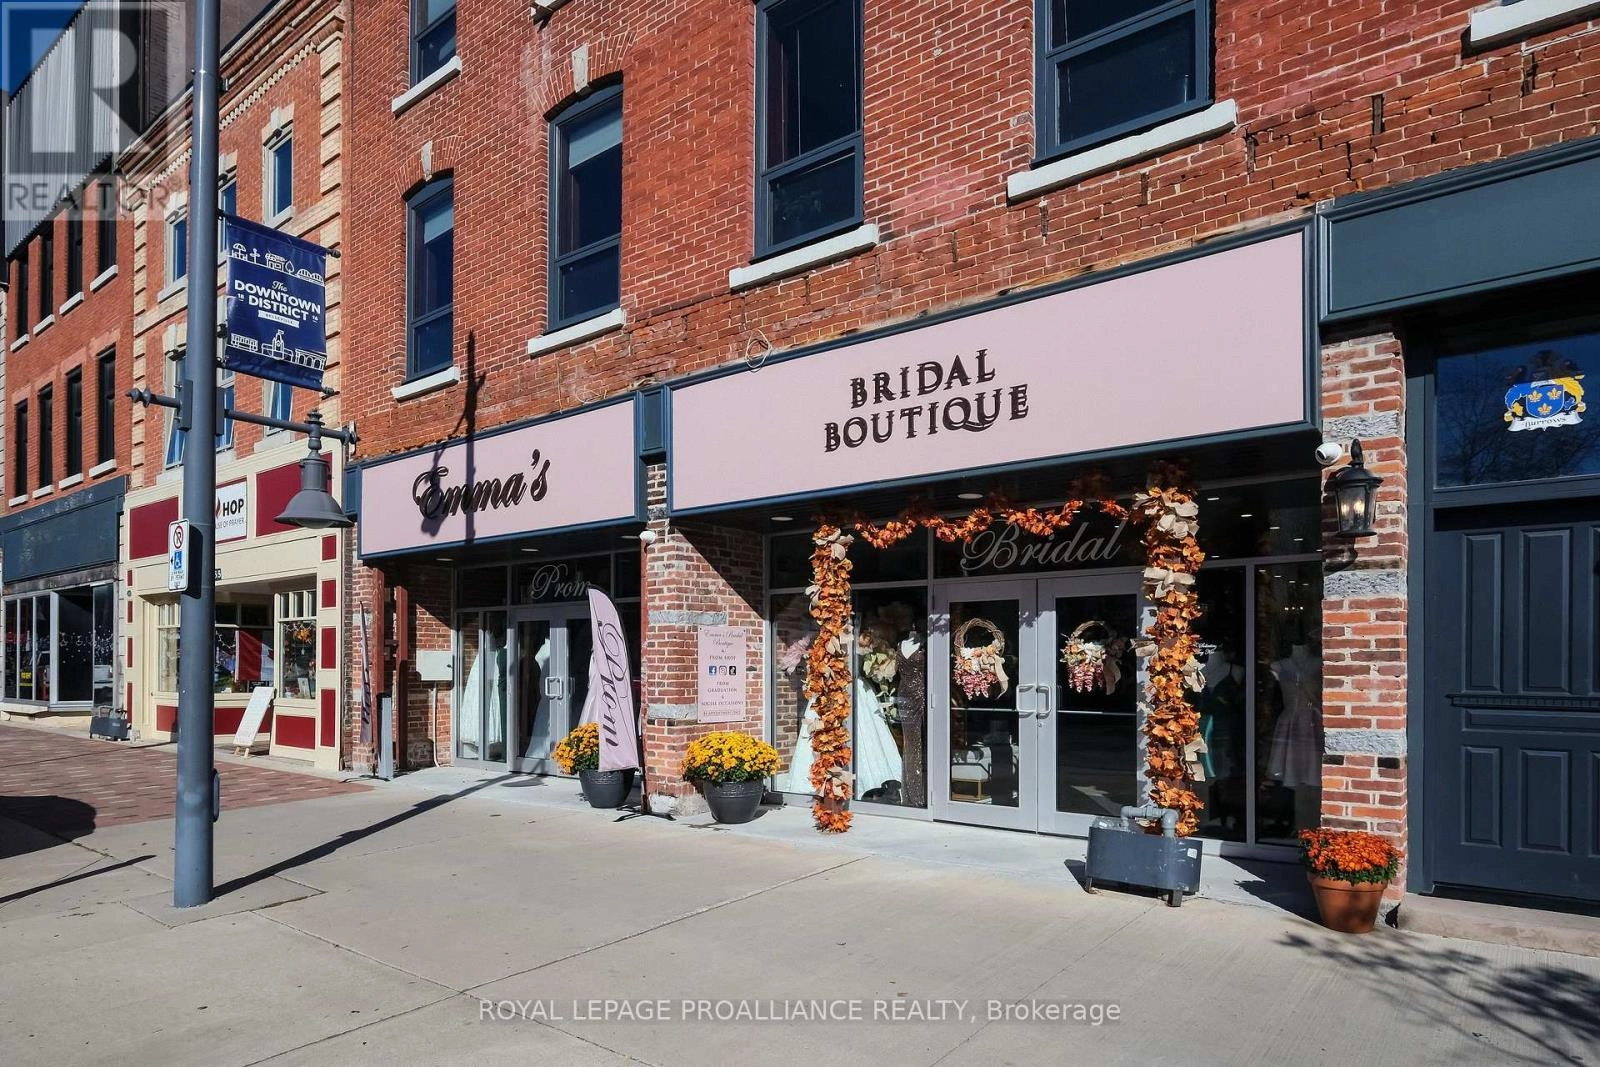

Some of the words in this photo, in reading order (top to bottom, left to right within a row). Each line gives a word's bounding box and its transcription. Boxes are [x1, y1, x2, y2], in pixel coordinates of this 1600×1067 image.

[234, 279, 320, 315] DOWNTOWN
[248, 294, 309, 321] DISTRICT
[272, 280, 288, 292] The
[850, 348, 996, 409] BRIDAL
[824, 384, 1029, 452] BOUTIQUE
[412, 449, 551, 519] Emma's
[222, 498, 245, 517] HOP
[959, 518, 1128, 571] Bridal
[530, 563, 589, 599] Prom
[597, 620, 630, 747] Prom
